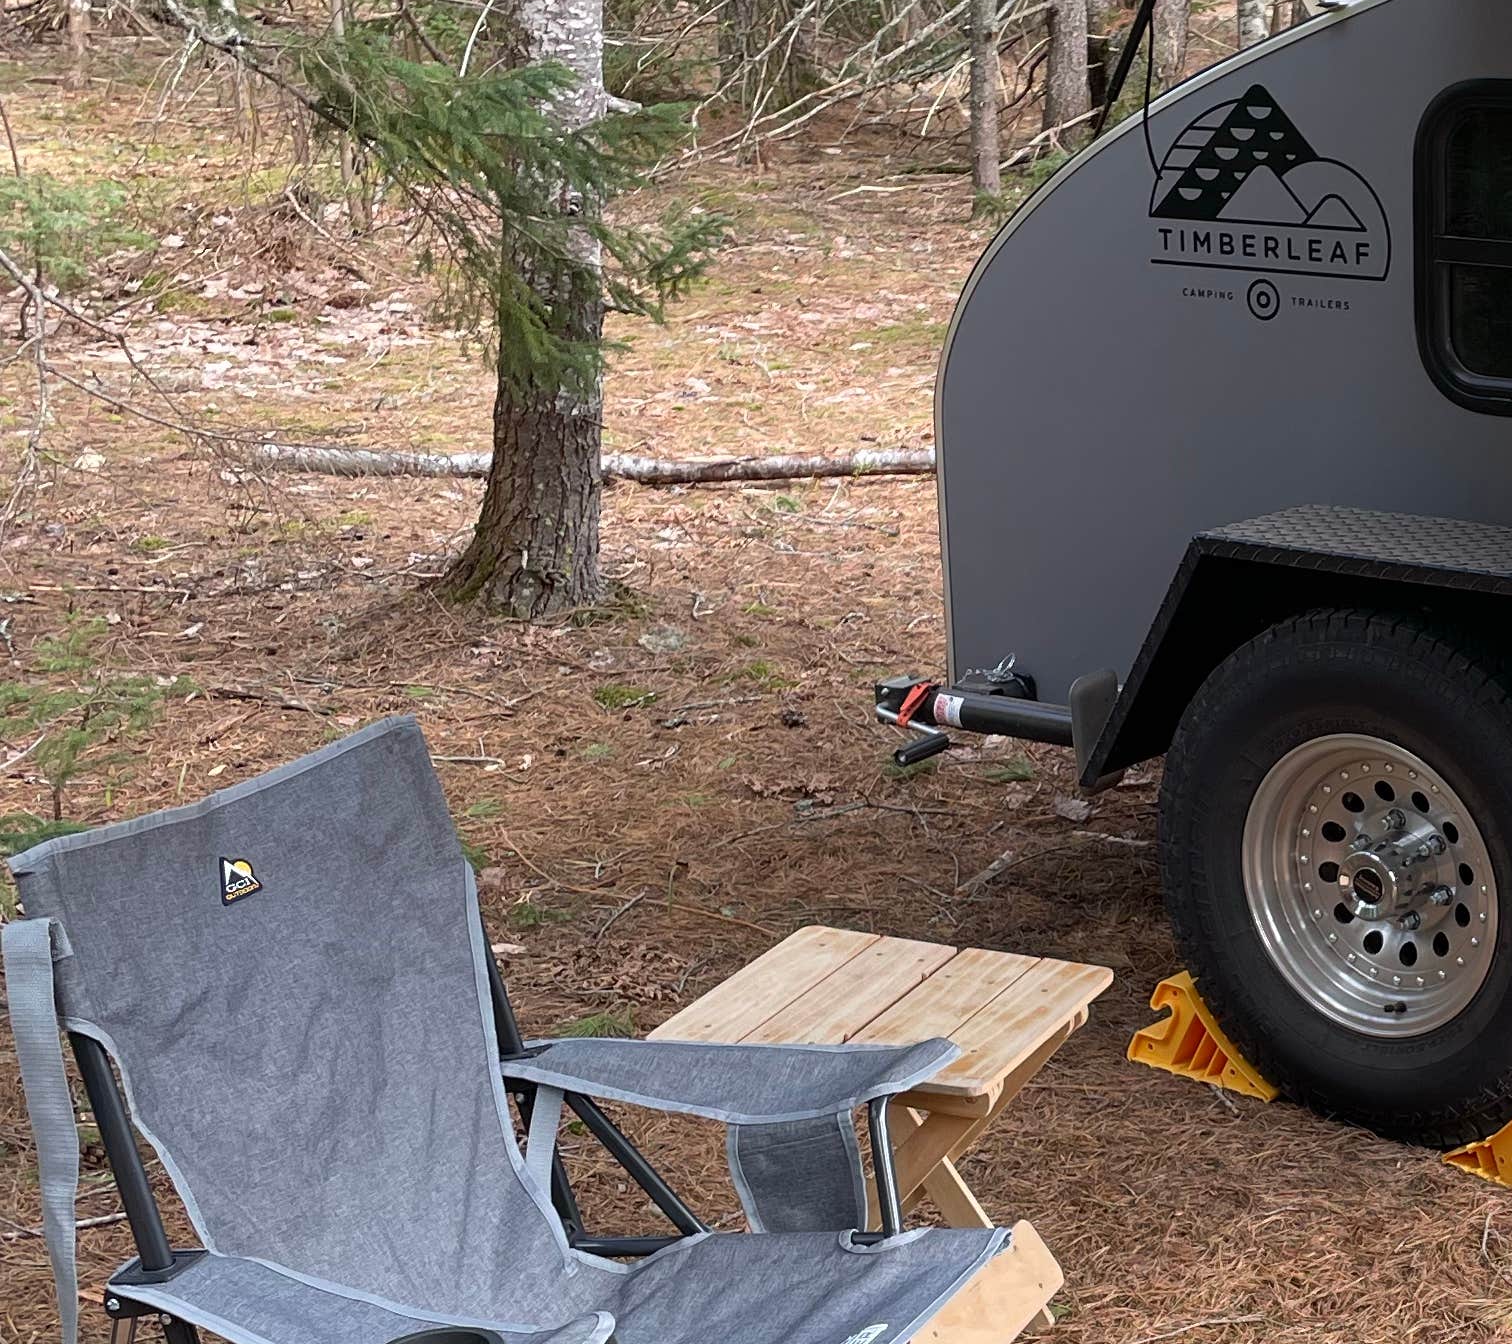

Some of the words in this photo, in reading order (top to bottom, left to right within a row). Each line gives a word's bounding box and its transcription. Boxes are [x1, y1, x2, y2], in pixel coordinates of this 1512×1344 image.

[1158, 228, 1370, 265] TIMBERLEAF
[1182, 287, 1234, 301] CAMPING
[1291, 297, 1350, 311] TRAILERS
[226, 877, 251, 893] GCI
